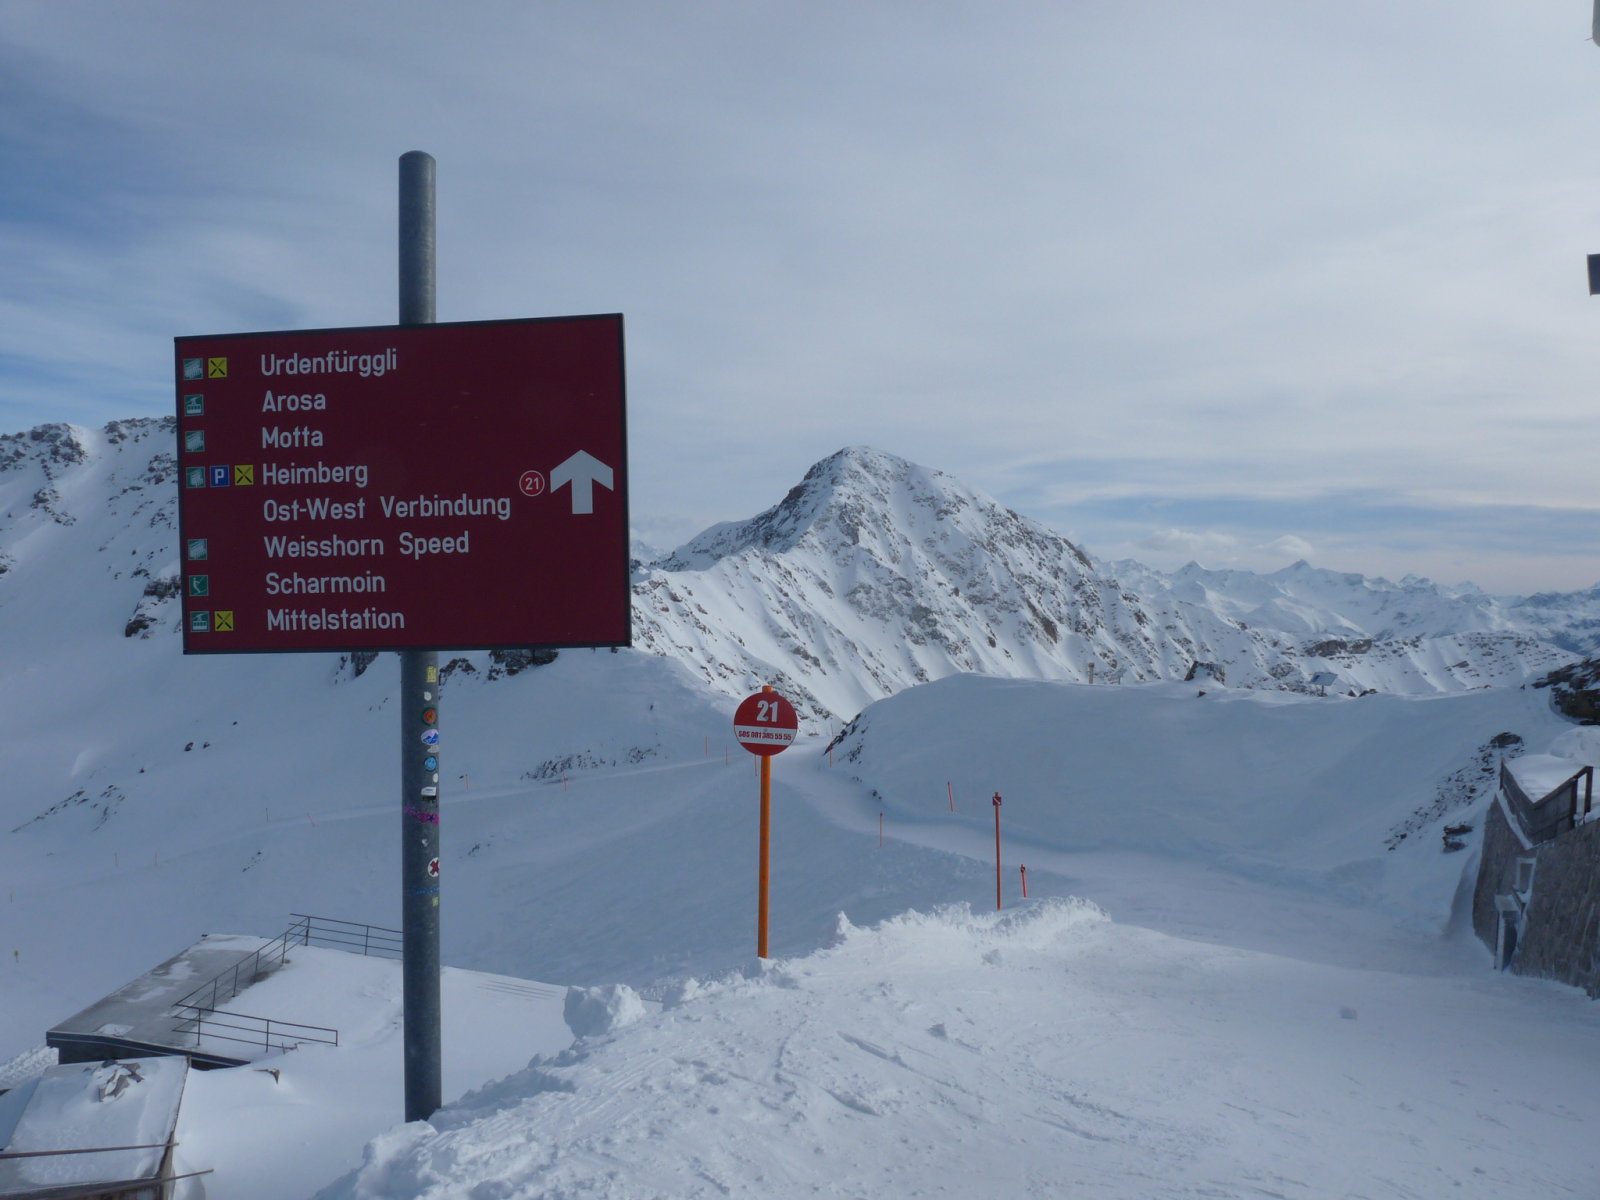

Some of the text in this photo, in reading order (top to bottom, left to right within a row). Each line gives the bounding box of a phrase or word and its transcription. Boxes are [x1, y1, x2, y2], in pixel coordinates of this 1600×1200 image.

[261, 348, 397, 377] Urdenfürggli
[262, 390, 326, 412] Arosa
[262, 426, 323, 449] Motta
[214, 468, 225, 485] P
[262, 461, 368, 488] Heimberg
[525, 477, 540, 491] 21
[263, 493, 511, 522] Ost-West Verbindung
[263, 530, 469, 560] Weisshorn Speed
[265, 570, 386, 595] Scharmoin
[267, 607, 405, 631] Mittelstation
[756, 700, 779, 723] 21
